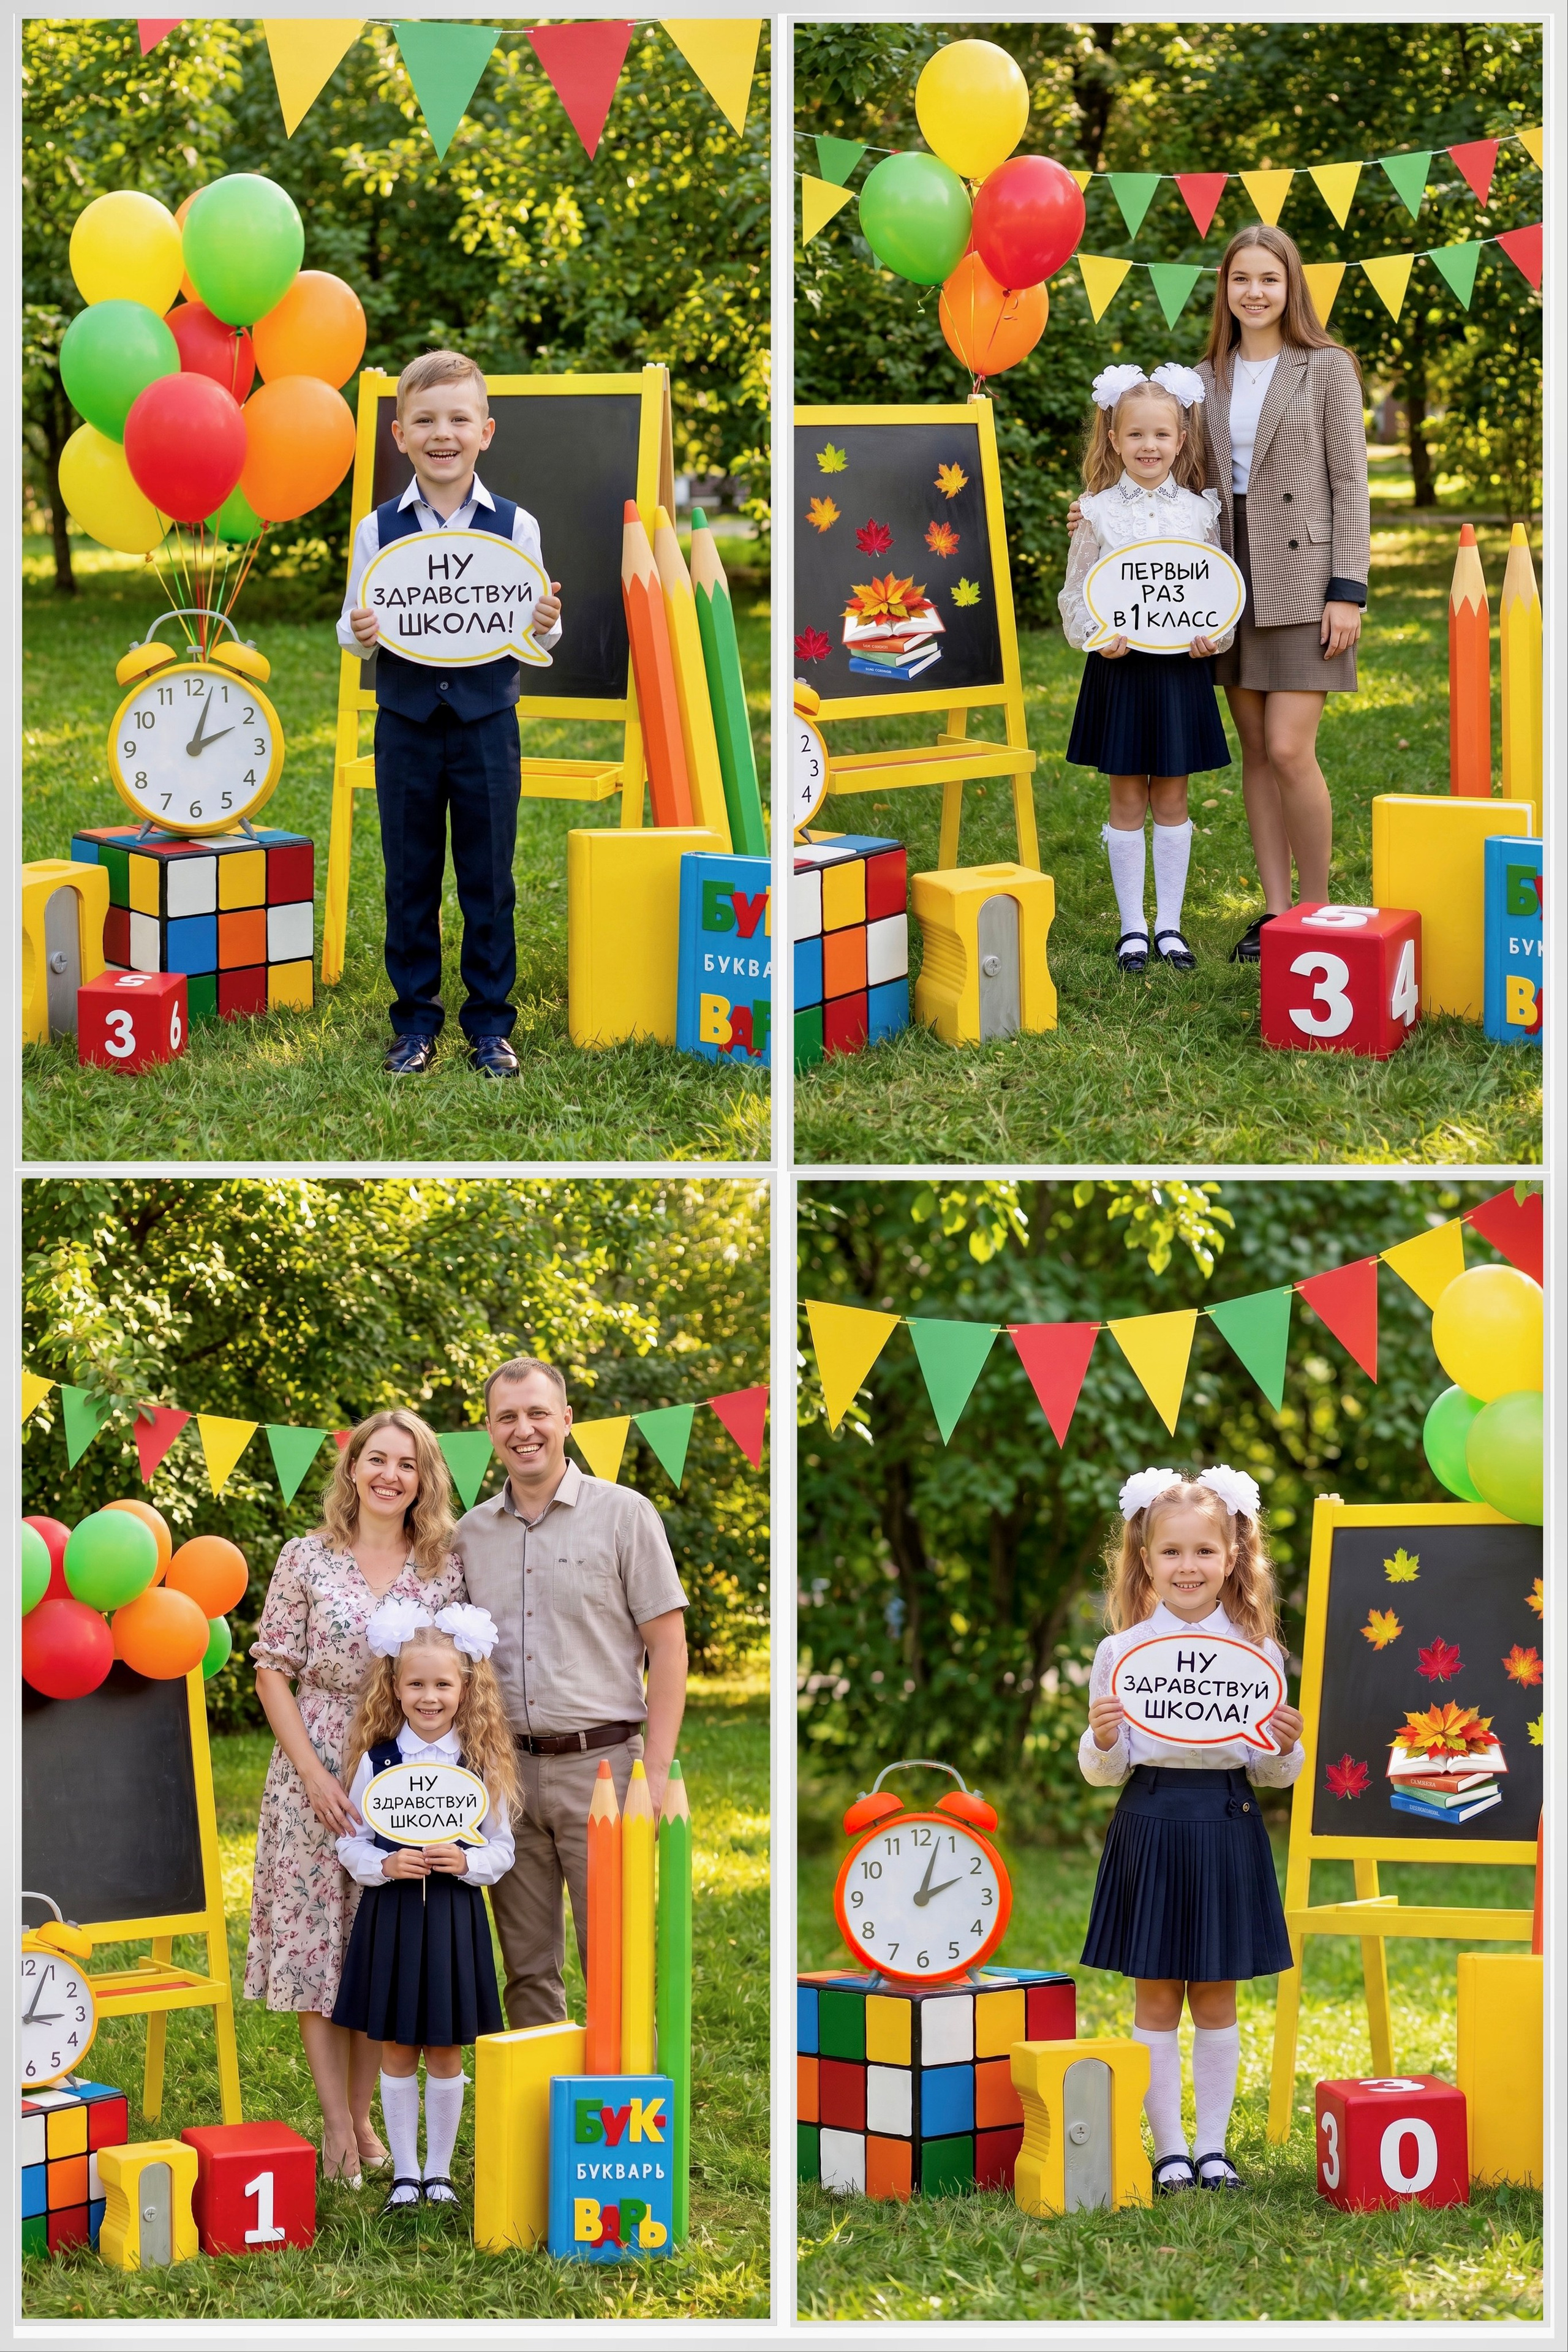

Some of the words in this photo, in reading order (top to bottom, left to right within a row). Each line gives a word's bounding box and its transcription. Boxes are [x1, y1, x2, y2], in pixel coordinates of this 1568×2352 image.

[428, 553, 473, 581] НУ
[1121, 559, 1209, 581] ПЕРВЫЙ
[373, 582, 532, 608] ЗДРАВСТВУЙ
[1142, 584, 1185, 603] РАЗ
[399, 611, 513, 636] ШКОЛА!
[1114, 611, 1126, 627] В
[1131, 603, 1139, 630] 1
[1147, 611, 1219, 628] КЛАСС
[184, 678, 205, 696] 12
[221, 685, 228, 703] 1
[157, 688, 173, 705] 11
[134, 711, 155, 729] 10
[243, 707, 255, 725] 2
[124, 741, 137, 758] 9
[254, 738, 266, 756] 3
[801, 735, 811, 752] 2
[243, 769, 256, 786] 4
[810, 760, 819, 777] 3
[135, 771, 148, 789] 8
[160, 793, 173, 810] 7
[221, 791, 233, 809] 5
[801, 785, 812, 803] 4
[189, 801, 203, 818] 6
[702, 880, 771, 939] БУ
[1301, 905, 1380, 927] 5
[1392, 939, 1418, 1027] 4
[1289, 951, 1354, 1037] 3
[105, 1009, 136, 1058] 3
[170, 1000, 181, 1050] 6
[1177, 1651, 1218, 1673] НУ
[1123, 1675, 1269, 1700] ЗДРАВСТВУЙ
[1145, 1699, 1250, 1724] ШКОЛА!
[410, 1775, 438, 1792] НУ
[372, 1793, 477, 1811] ЗДРАВСТВУЙ
[391, 1813, 463, 1828] ШКОЛА!
[911, 1828, 932, 1846] 12
[948, 1836, 956, 1853] 1
[884, 1838, 900, 1855] 11
[861, 1861, 883, 1879] 10
[970, 1857, 982, 1874] 2
[851, 1891, 864, 1909] 9
[981, 1888, 993, 1905] 3
[862, 1921, 875, 1939] 8
[970, 1919, 983, 1936] 4
[888, 1943, 900, 1961] 7
[916, 1950, 930, 1968] 6
[948, 1942, 960, 1959] 5
[50, 1965, 55, 1980] 1
[66, 1981, 77, 1998] 2
[75, 2006, 86, 2022] 3
[67, 2031, 78, 2046] 4
[25, 2060, 36, 2076] 6
[50, 2051, 61, 2068] 5
[1359, 2079, 1425, 2092] 3
[1321, 2112, 1340, 2190] 3
[1380, 2118, 1438, 2193] 0
[577, 2163, 665, 2179] БУКВАРЬ
[245, 2172, 285, 2244] 1
[574, 2198, 668, 2248] ВАРЬ
